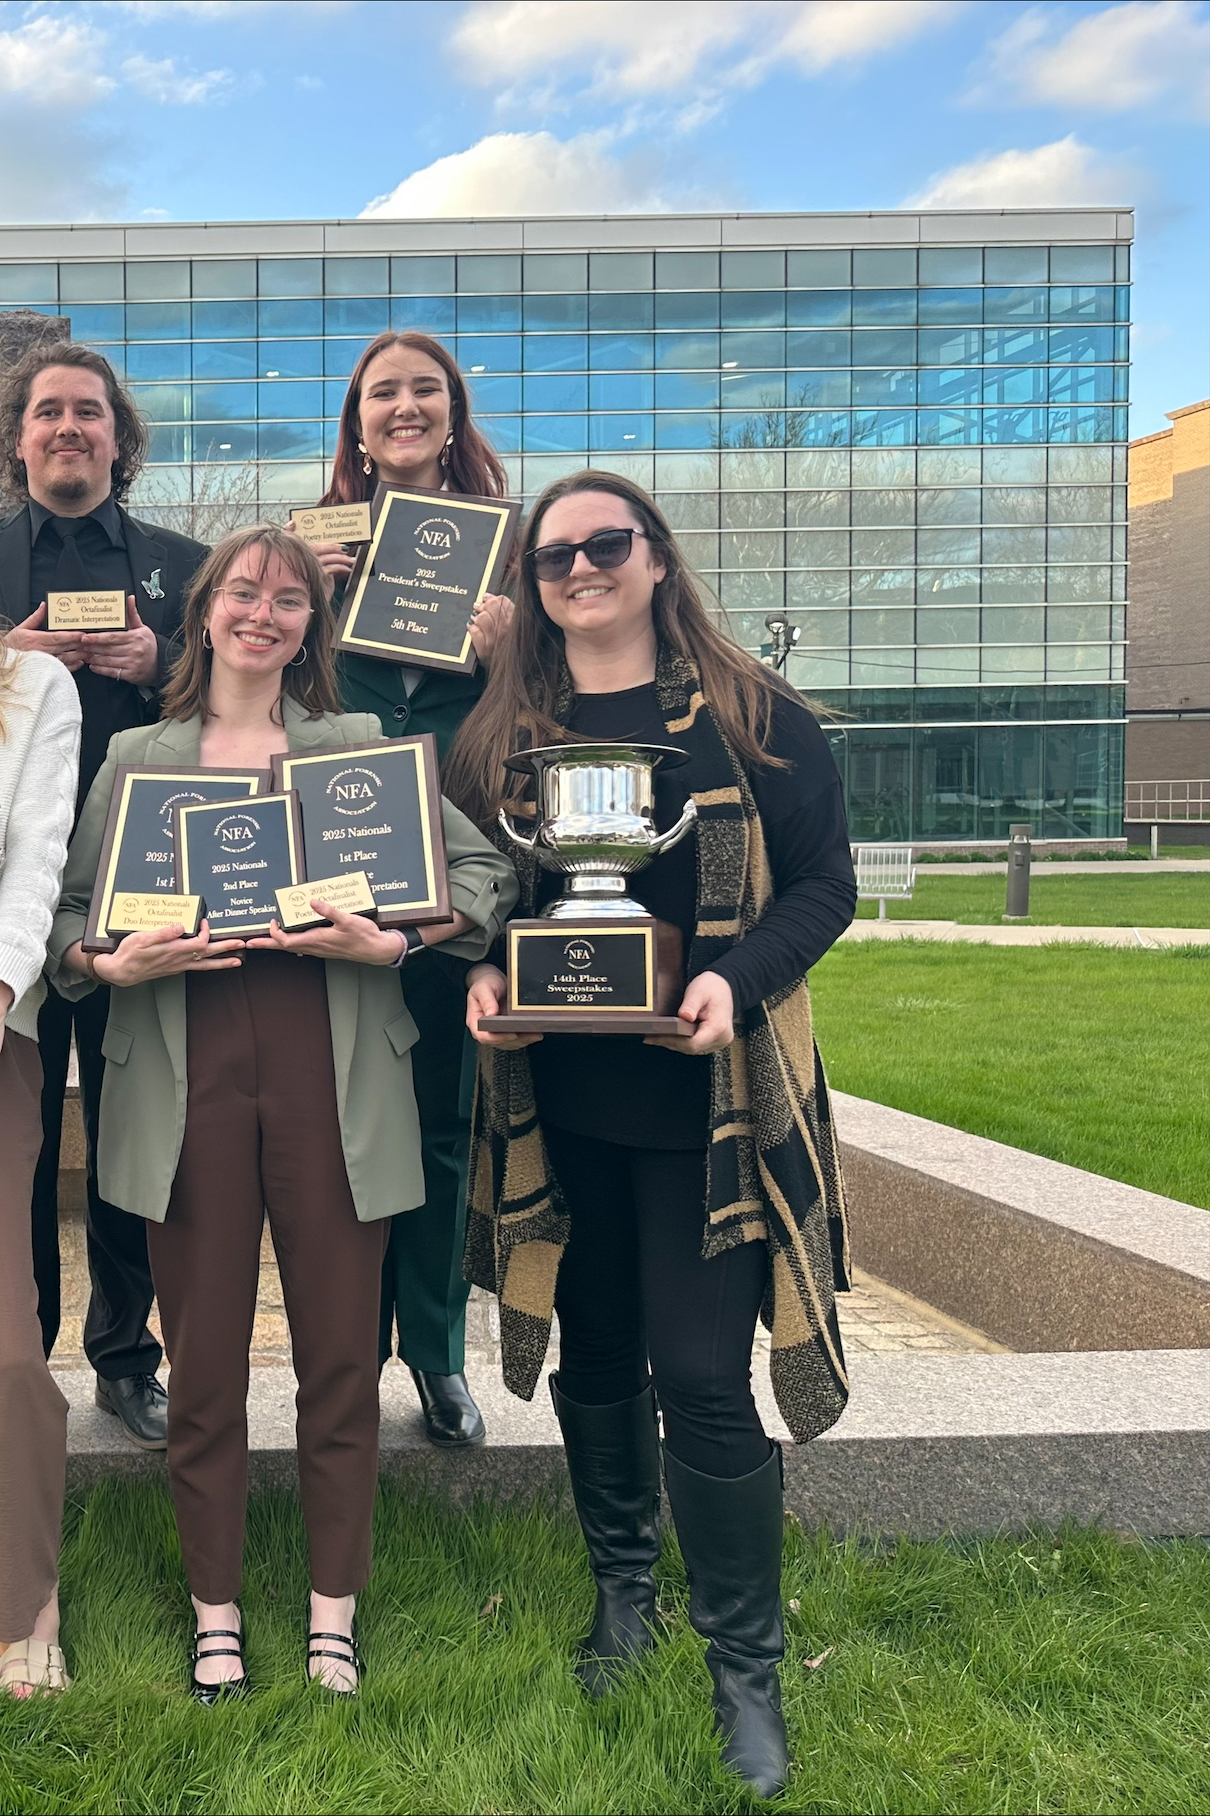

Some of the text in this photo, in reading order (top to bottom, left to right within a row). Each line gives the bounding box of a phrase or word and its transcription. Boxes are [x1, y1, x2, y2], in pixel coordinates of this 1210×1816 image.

[336, 509, 363, 518] Nationals
[326, 520, 358, 529] Octafinalist
[323, 530, 362, 539] Interpretation
[420, 530, 452, 548] NFA
[416, 568, 436, 578] 2025
[378, 573, 468, 596] President's Sweepstakes
[394, 597, 439, 613] Division II
[391, 618, 429, 634] 5th Place
[326, 767, 382, 794] NATIONAL FORENSIC
[335, 782, 374, 800] NFA
[159, 792, 190, 815] NATIONAL
[333, 801, 377, 815] ASSOCIATION
[214, 814, 260, 836] NATIONAL FORENSIC
[222, 826, 253, 841] NFA
[322, 824, 392, 841] 2025 Nationals
[145, 852, 168, 862] 2025
[340, 851, 378, 863] 1st Place
[212, 860, 267, 873] 2025 Nationals
[156, 877, 167, 887] 1st
[223, 880, 258, 890] 2nd Place
[310, 880, 359, 896] 2025 Nationals
[371, 880, 408, 893] pretation
[230, 897, 253, 905] Novice
[318, 890, 356, 902] Octafinalist
[148, 908, 182, 916] Octafinalist
[206, 910, 224, 919] After
[225, 908, 248, 916] Dinner
[140, 918, 181, 926] Interpretation
[569, 949, 590, 960] NFA
[553, 974, 608, 983] 14th Place
[547, 985, 613, 994] Sweepstakes
